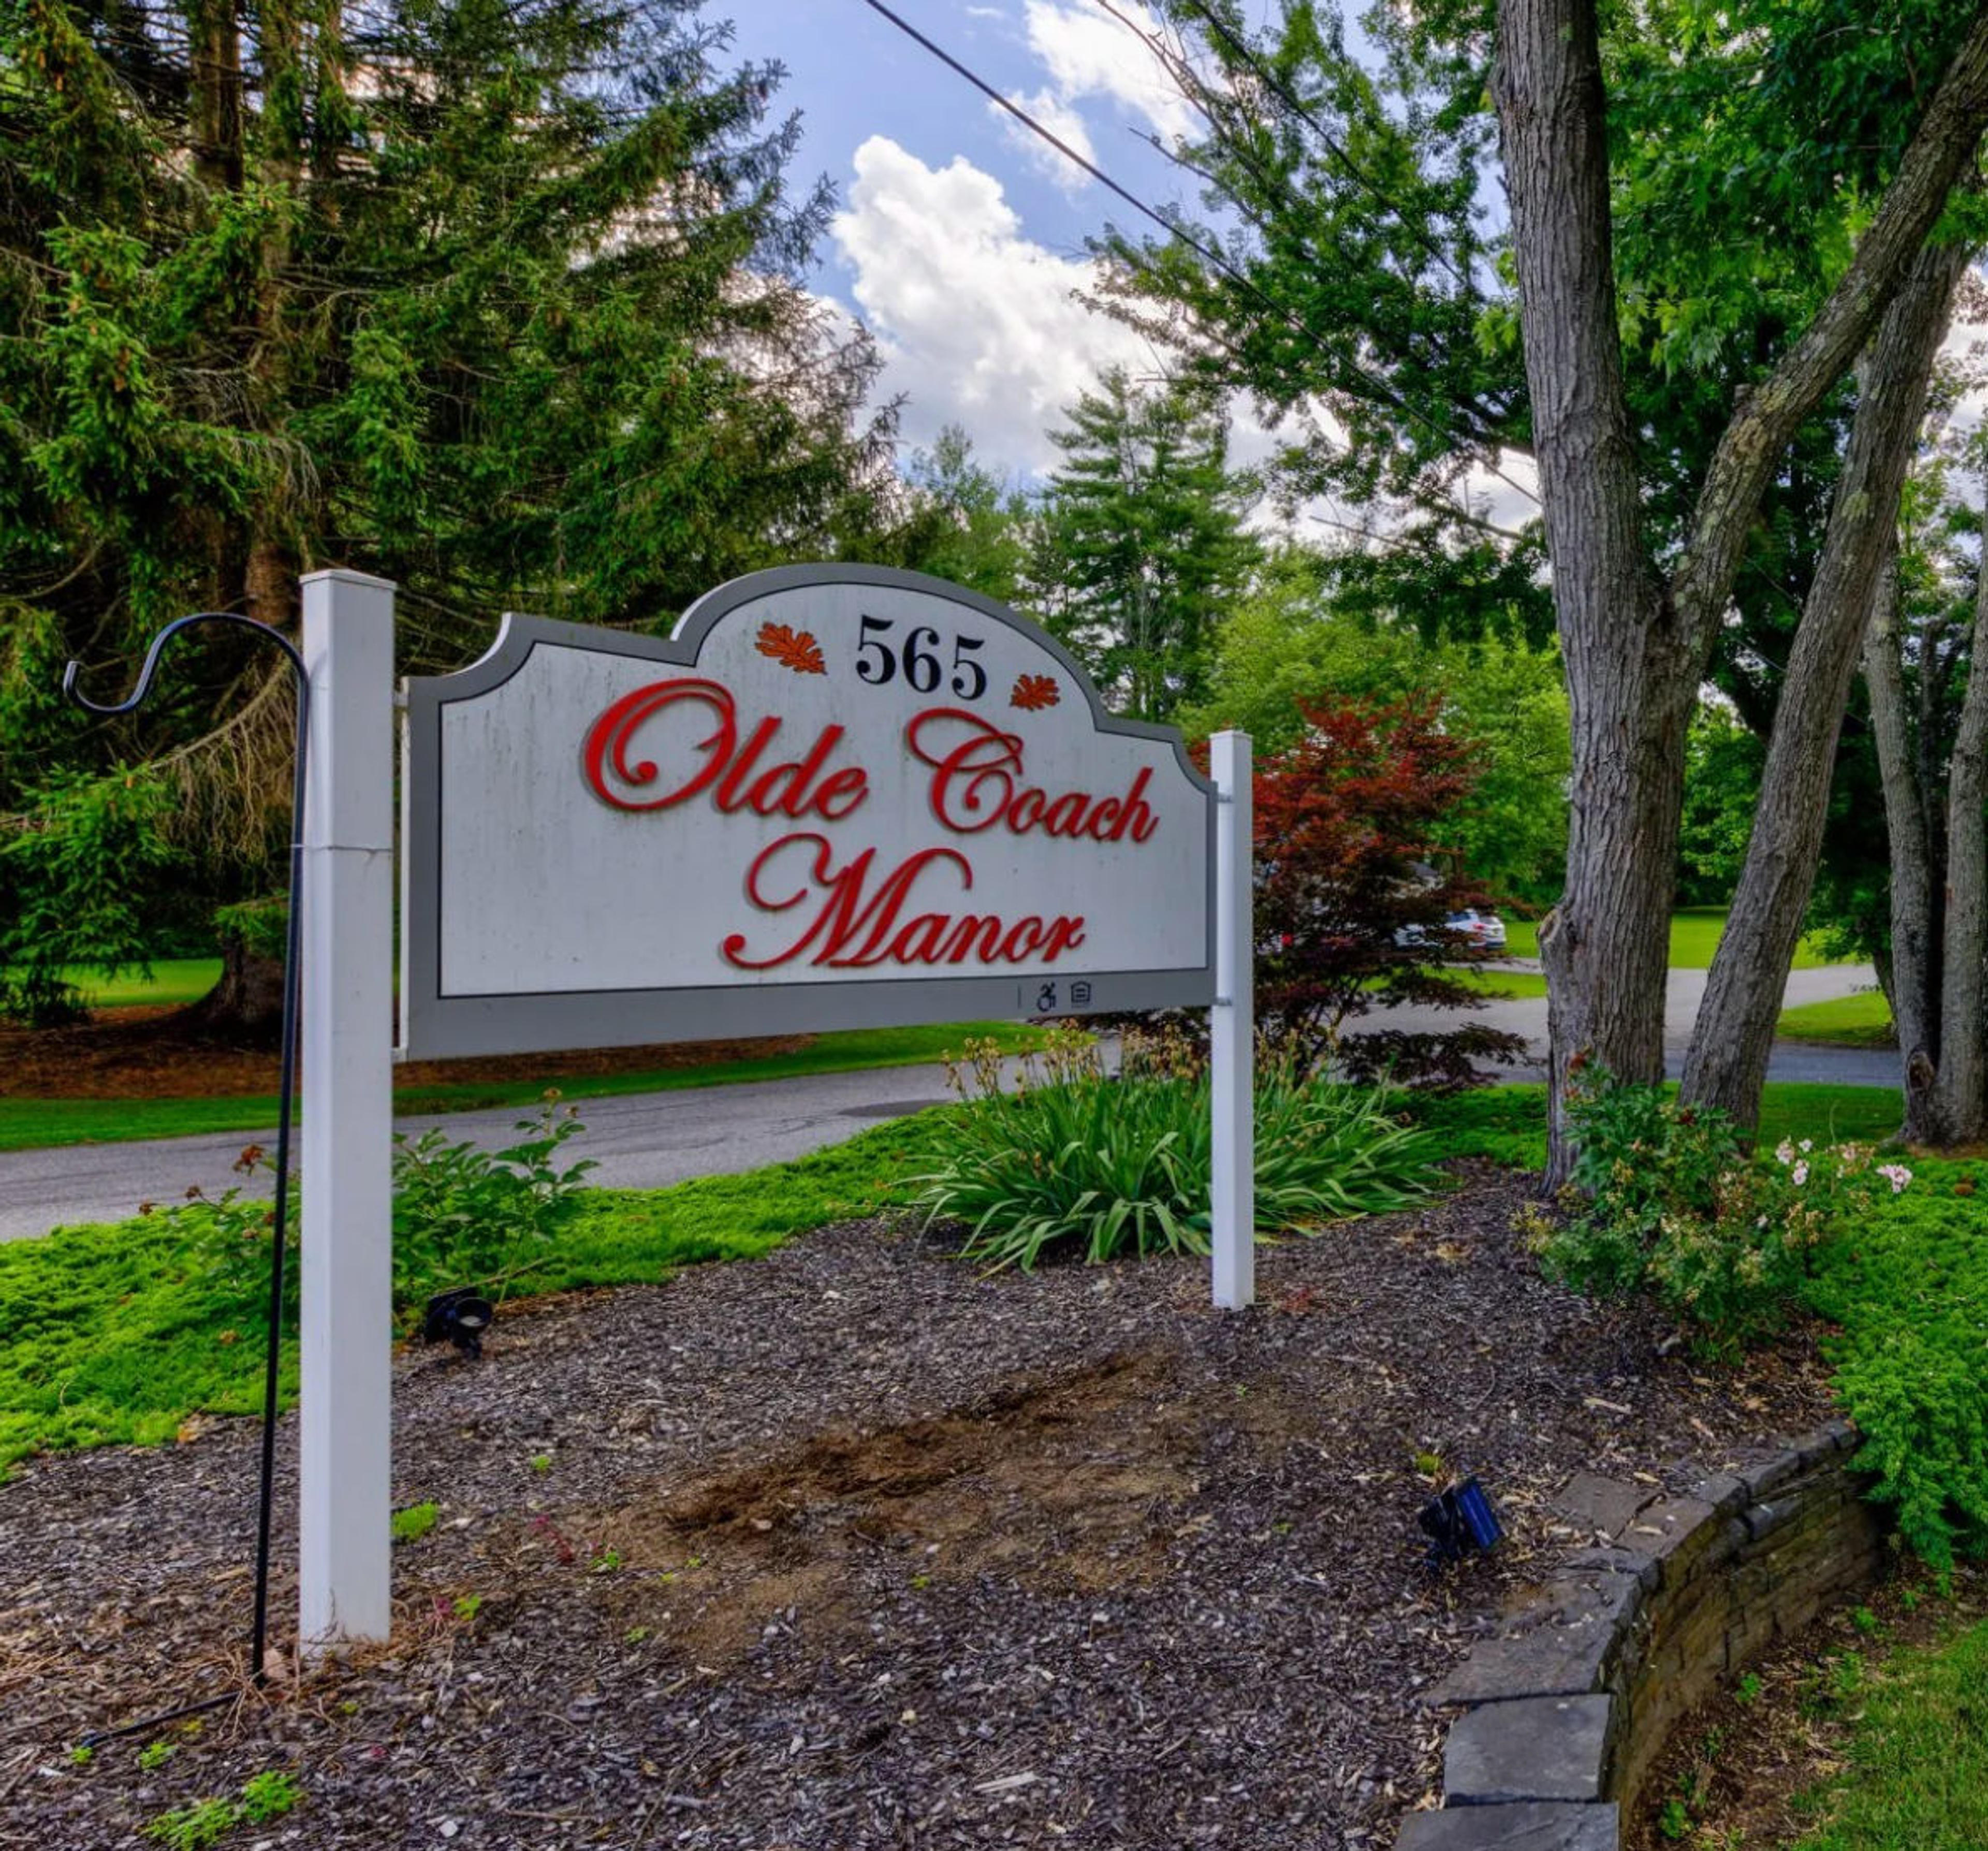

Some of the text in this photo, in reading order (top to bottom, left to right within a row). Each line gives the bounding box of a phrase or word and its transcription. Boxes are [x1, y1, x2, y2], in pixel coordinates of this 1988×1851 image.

[855, 614, 988, 701] 565
[583, 677, 1159, 842] Olde Coach
[722, 833, 1086, 969] Manor
